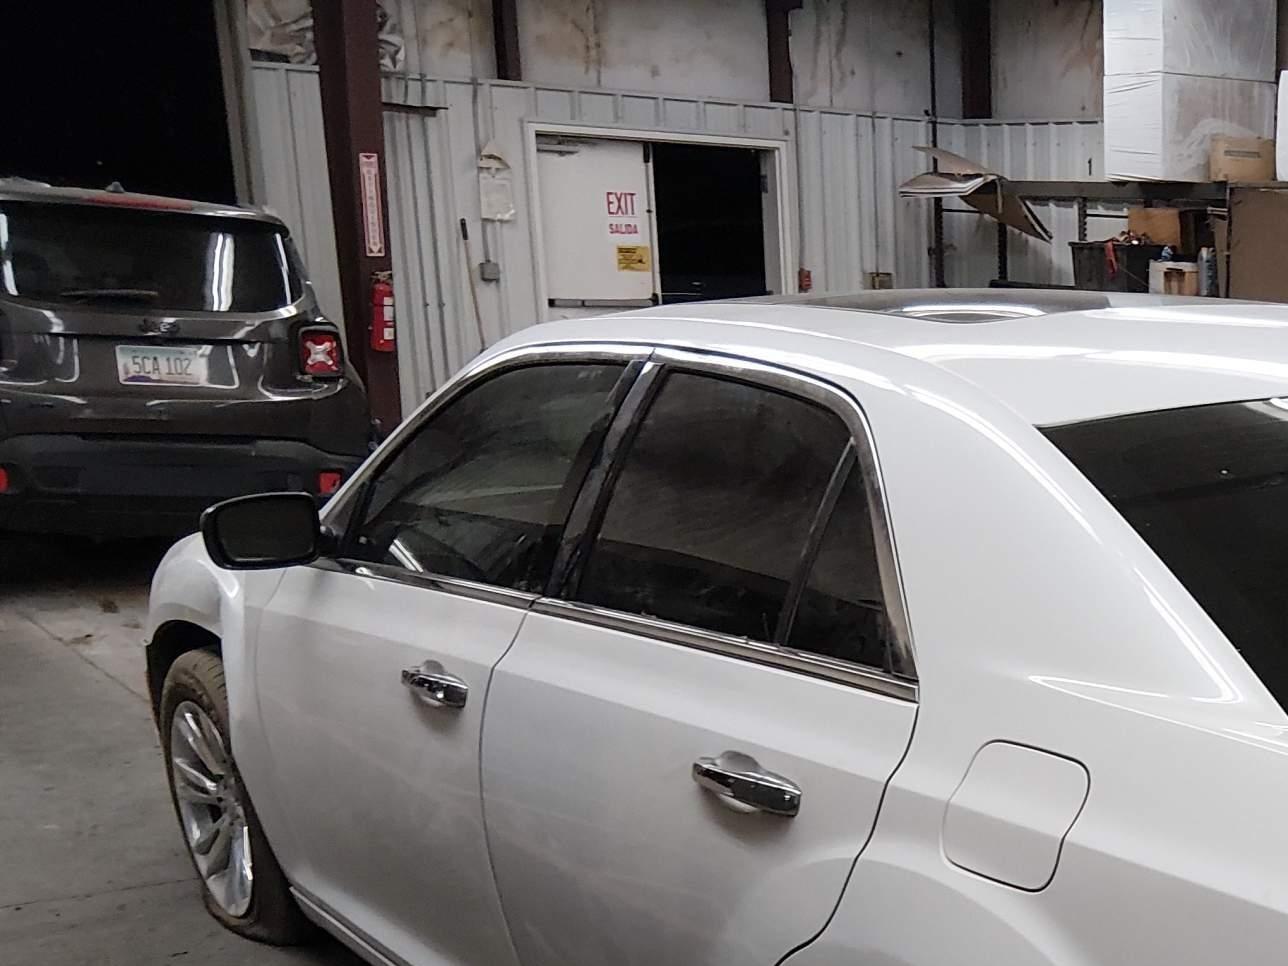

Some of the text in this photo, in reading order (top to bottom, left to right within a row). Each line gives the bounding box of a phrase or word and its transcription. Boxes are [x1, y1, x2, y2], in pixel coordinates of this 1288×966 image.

[606, 192, 636, 215] EXIT
[608, 223, 638, 234] SALIDA
[131, 355, 192, 376] 5CA 102
